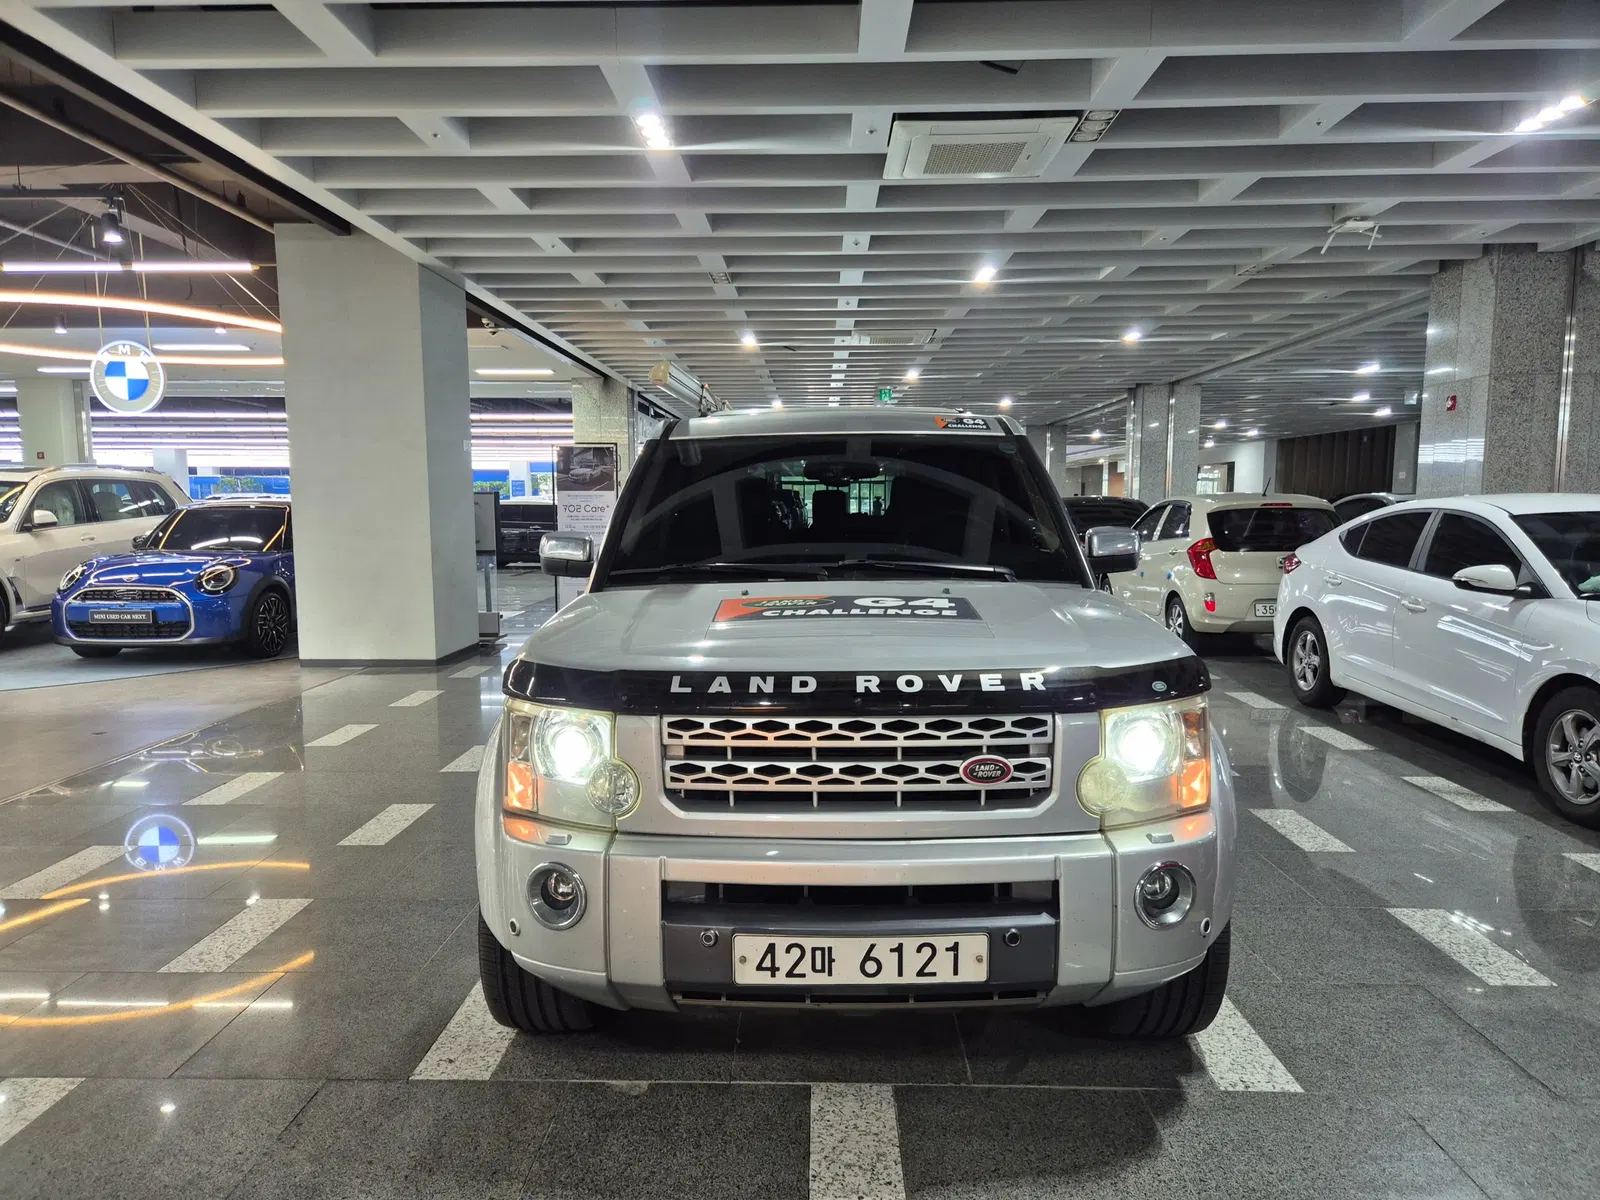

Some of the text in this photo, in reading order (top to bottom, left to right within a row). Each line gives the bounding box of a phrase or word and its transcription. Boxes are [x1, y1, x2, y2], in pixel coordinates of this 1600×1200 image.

[853, 597, 956, 609] G4
[761, 608, 959, 617] CHALLENGE
[1261, 605, 1277, 615] 35
[669, 672, 1048, 694] LAND ROVER
[755, 941, 960, 979] 42마 6121
